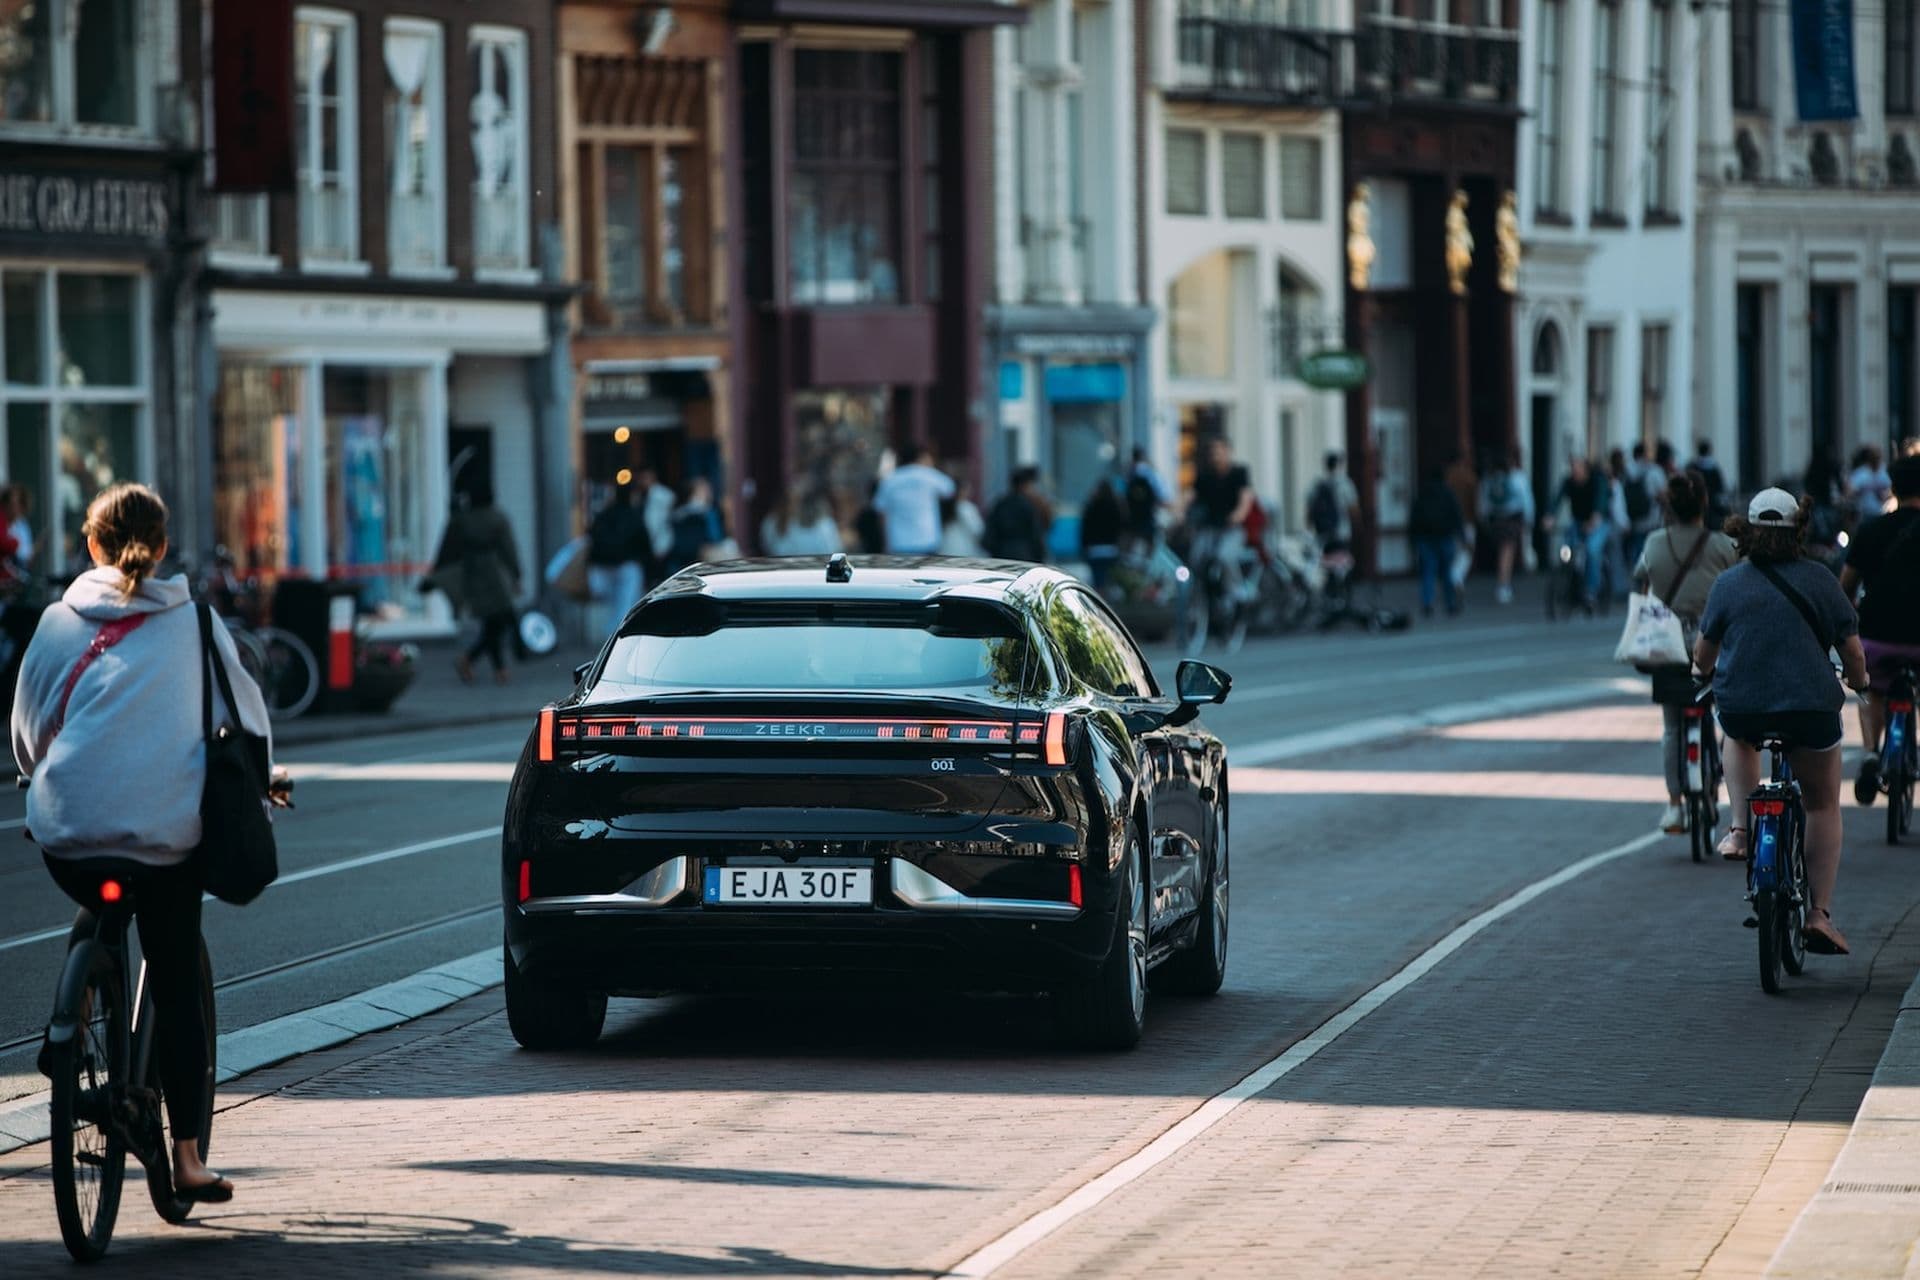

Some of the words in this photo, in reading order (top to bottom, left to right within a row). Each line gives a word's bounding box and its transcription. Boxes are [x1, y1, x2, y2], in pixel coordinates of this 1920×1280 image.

[755, 724, 826, 735] ZEEKR
[931, 758, 956, 771] 001
[732, 871, 788, 898] EJA
[799, 872, 857, 899] 30F
[709, 887, 716, 896] S
